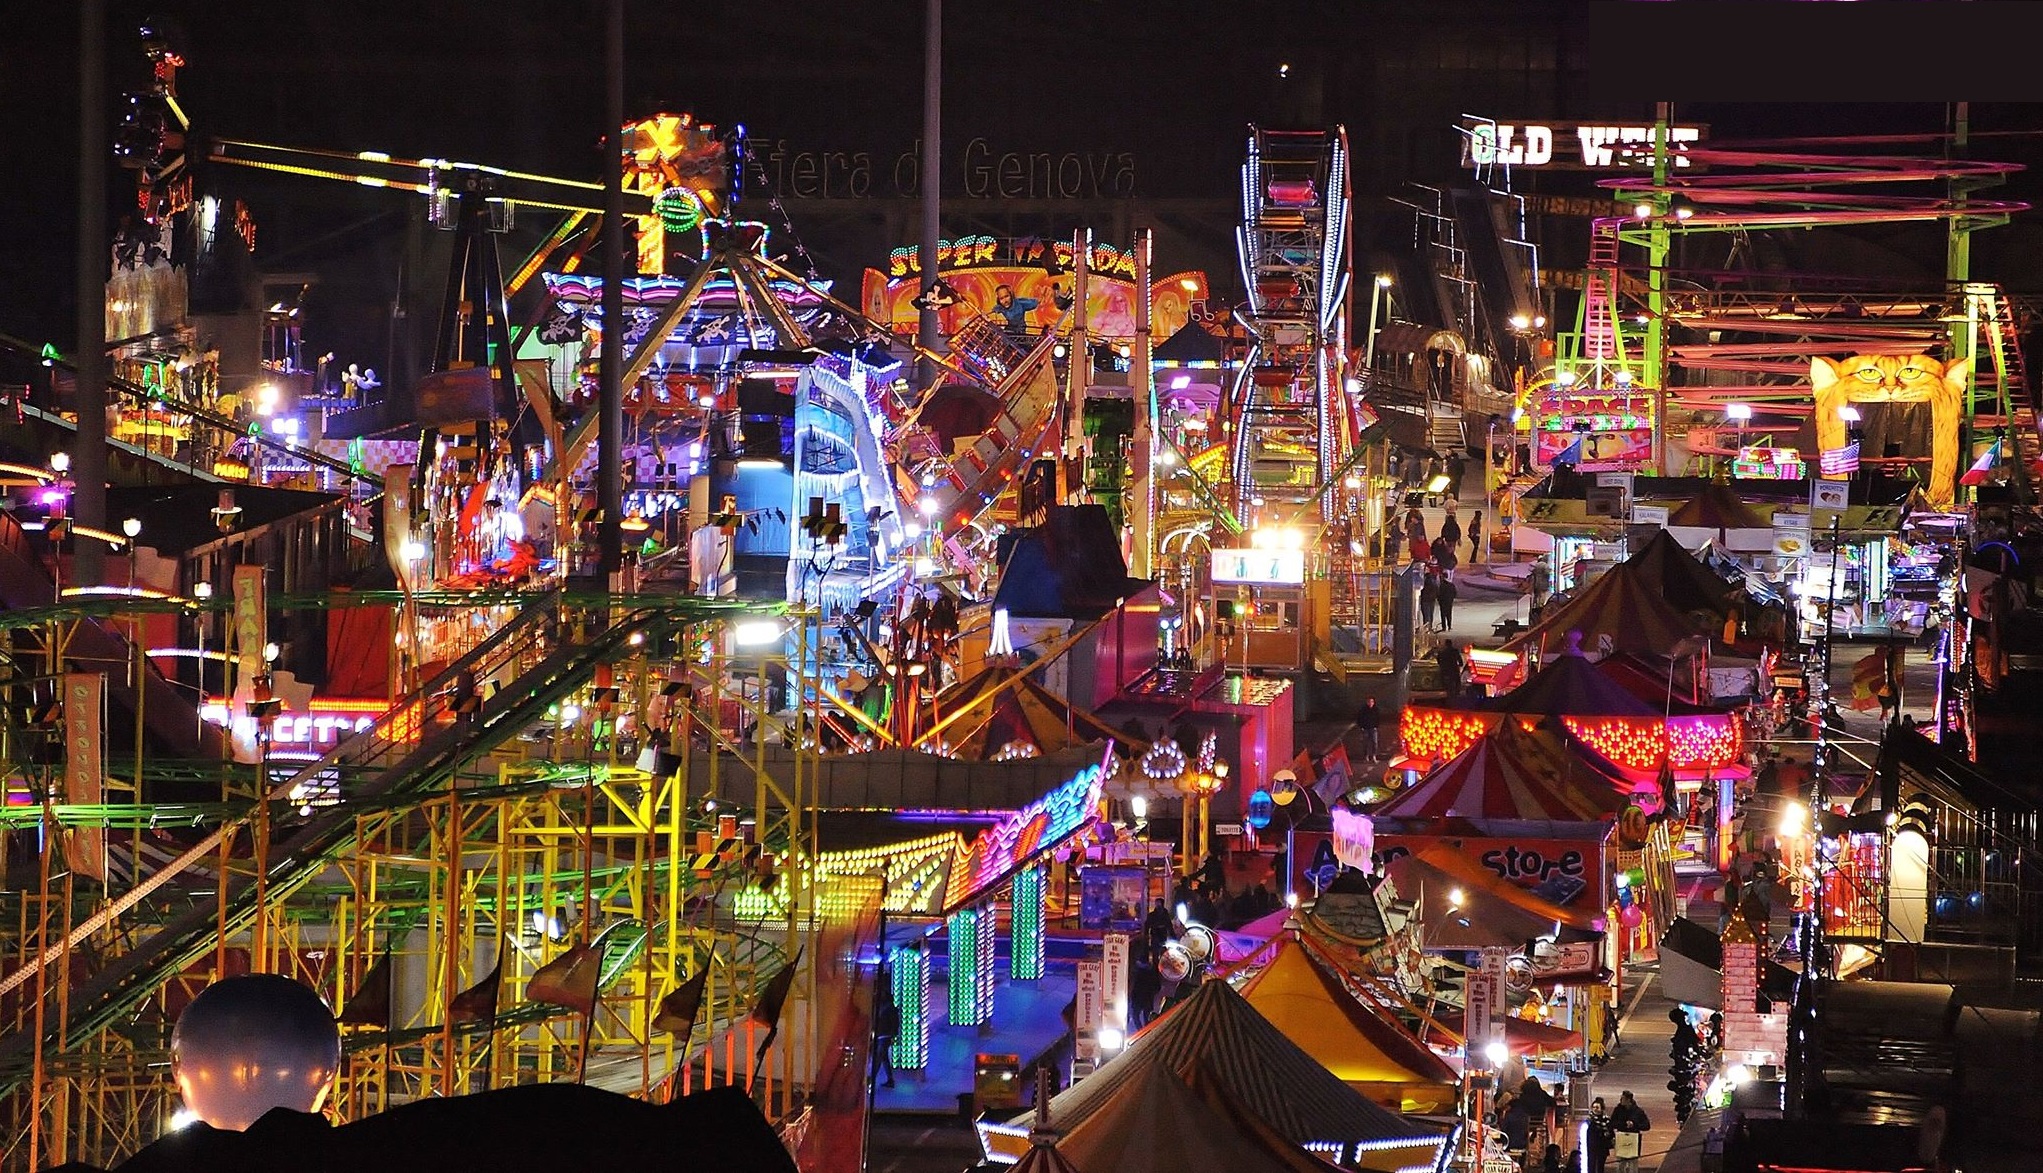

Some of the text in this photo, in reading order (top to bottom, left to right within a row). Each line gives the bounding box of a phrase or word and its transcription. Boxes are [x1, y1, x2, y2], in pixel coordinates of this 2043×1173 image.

[1471, 124, 1553, 165] OLD
[742, 138, 872, 199] Fiera
[964, 137, 1139, 199] Genova
[889, 235, 1138, 281] SUPER TAGDA
